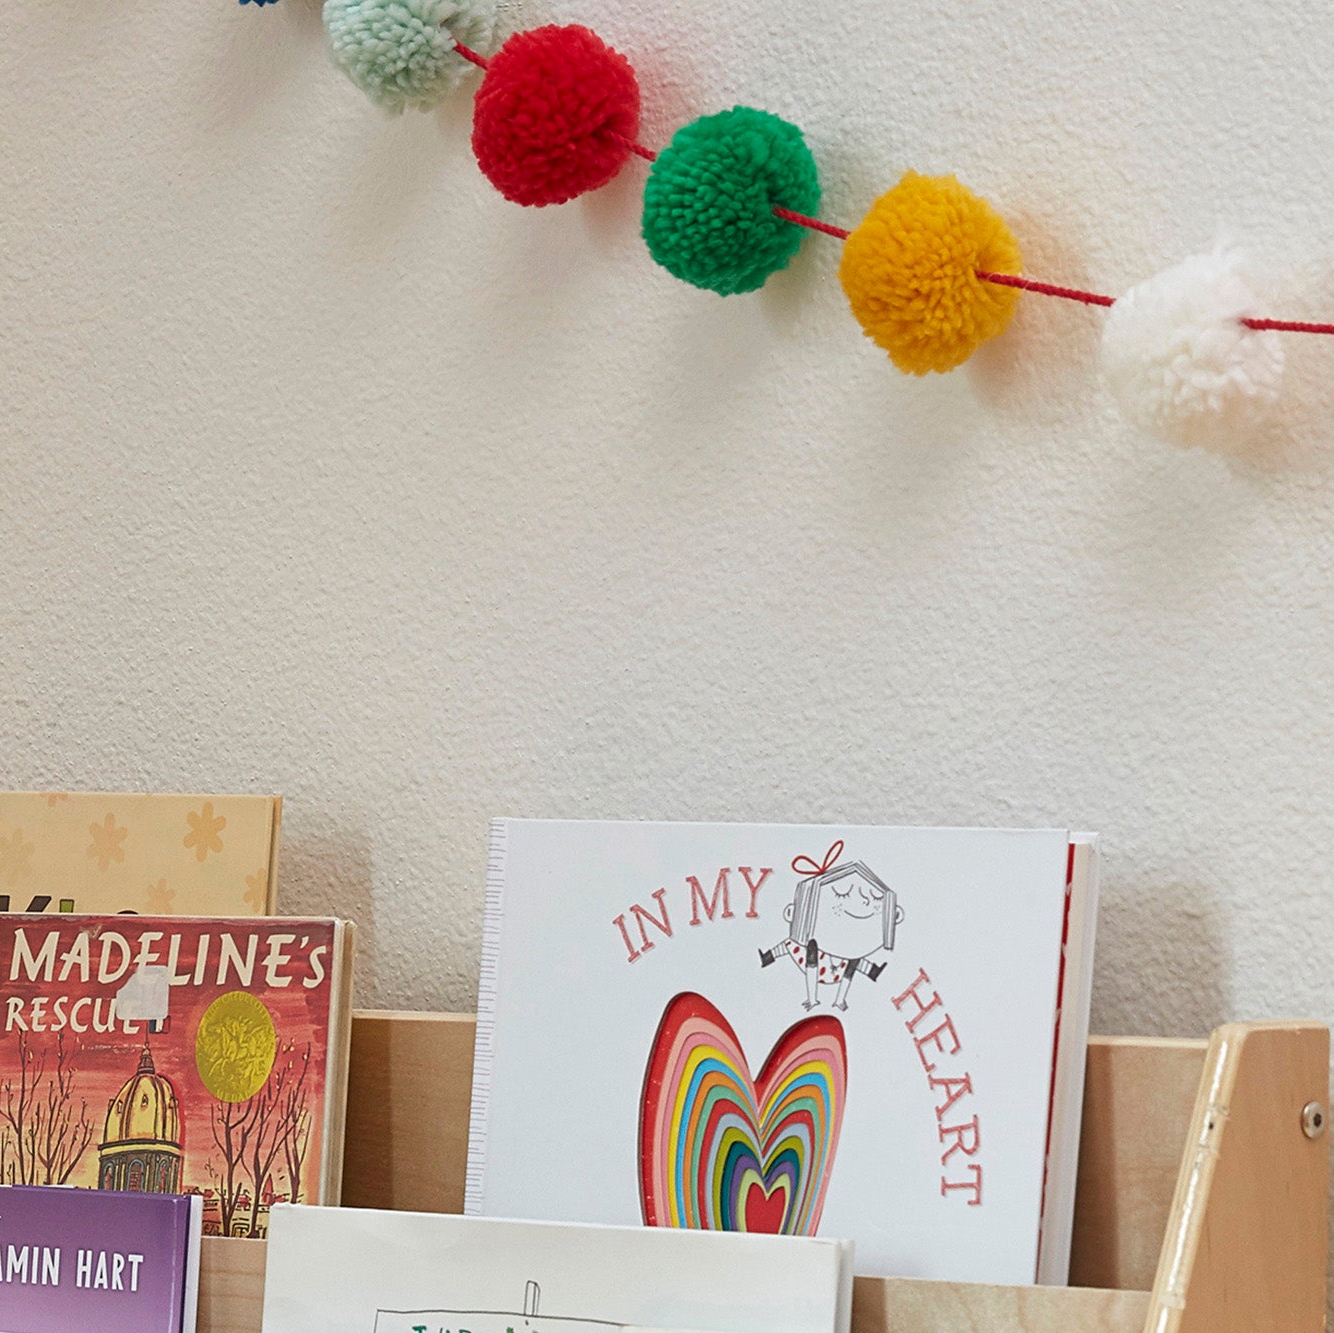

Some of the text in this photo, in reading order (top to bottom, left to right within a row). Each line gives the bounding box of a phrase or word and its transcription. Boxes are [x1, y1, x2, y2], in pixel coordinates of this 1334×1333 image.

[9, 927, 327, 989] MADELINE'S
[612, 865, 984, 1207] IN MY HEART
[75, 1249, 144, 1292] HART
